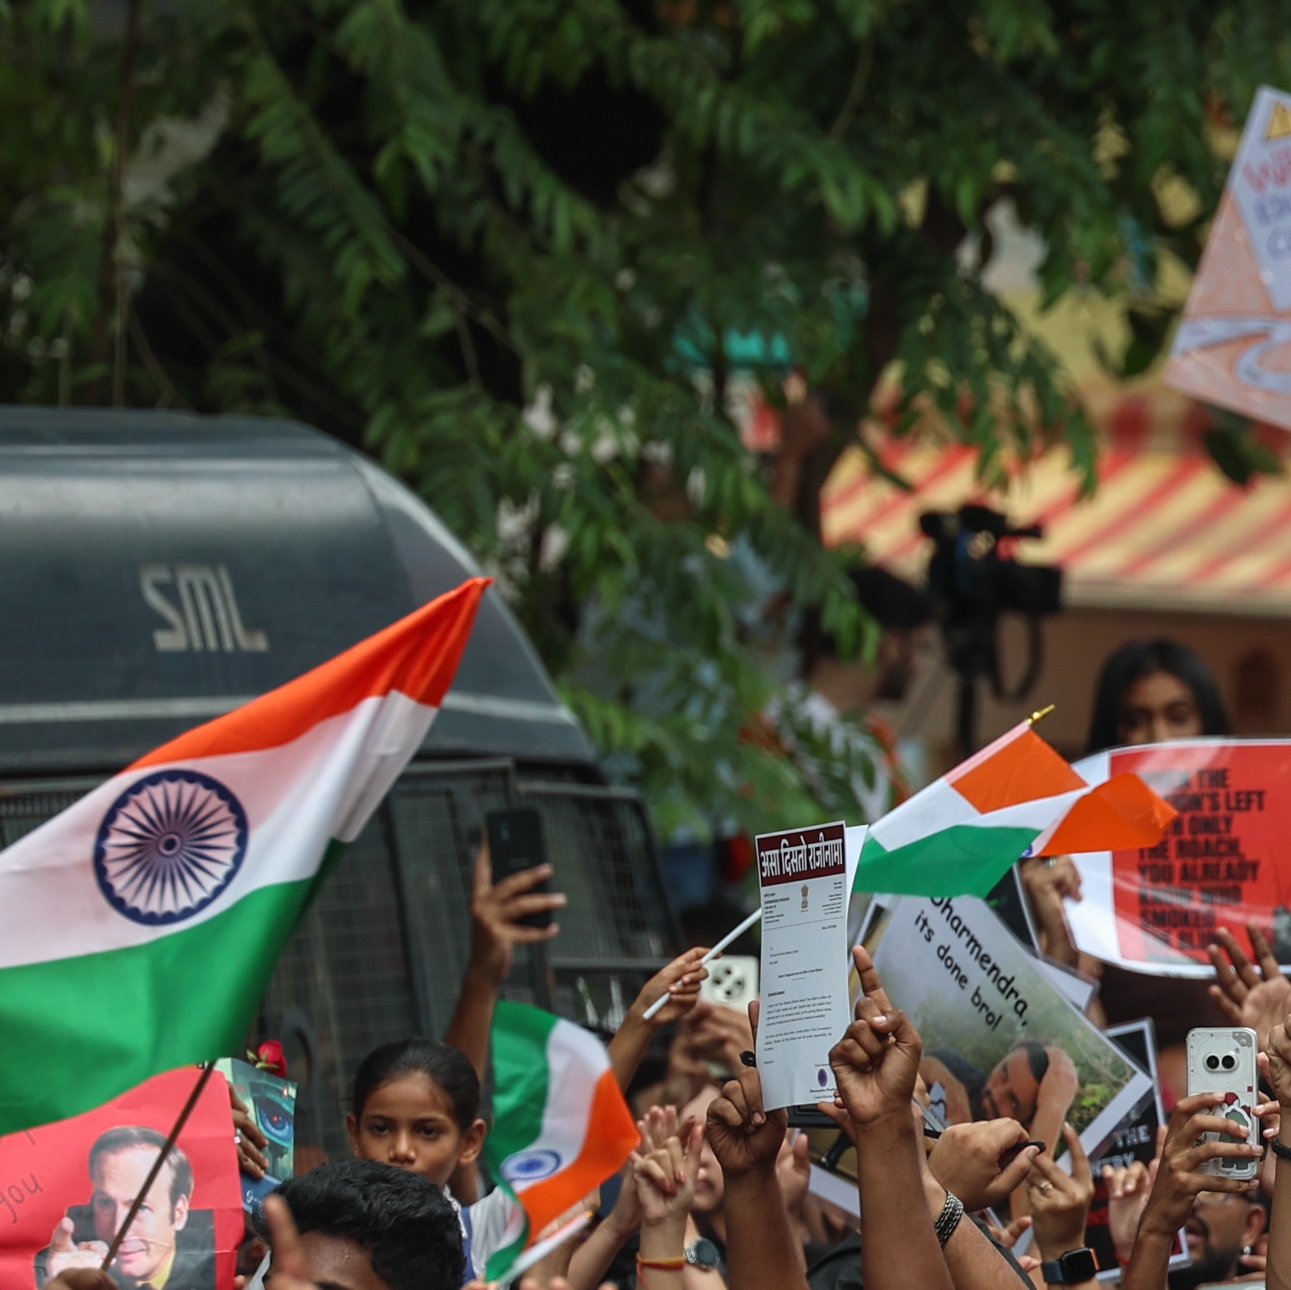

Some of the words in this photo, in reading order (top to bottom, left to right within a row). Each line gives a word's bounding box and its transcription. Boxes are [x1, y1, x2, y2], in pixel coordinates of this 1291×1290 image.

[140, 564, 269, 653] SML
[1197, 768, 1229, 788] THE
[1226, 790, 1265, 811] LEFT
[1189, 816, 1233, 834] ONLY
[761, 849, 780, 877] असा
[780, 835, 808, 876] दिसतो
[808, 831, 843, 870] राजीनामा
[1139, 864, 1173, 882] YOU
[1181, 860, 1261, 882] ALREADY
[1139, 887, 1192, 906] KNOW
[1199, 885, 1242, 904] WHO
[1140, 909, 1216, 928] SMOKED
[914, 909, 935, 943] its
[936, 944, 968, 990] done
[1114, 1124, 1151, 1149] THE
